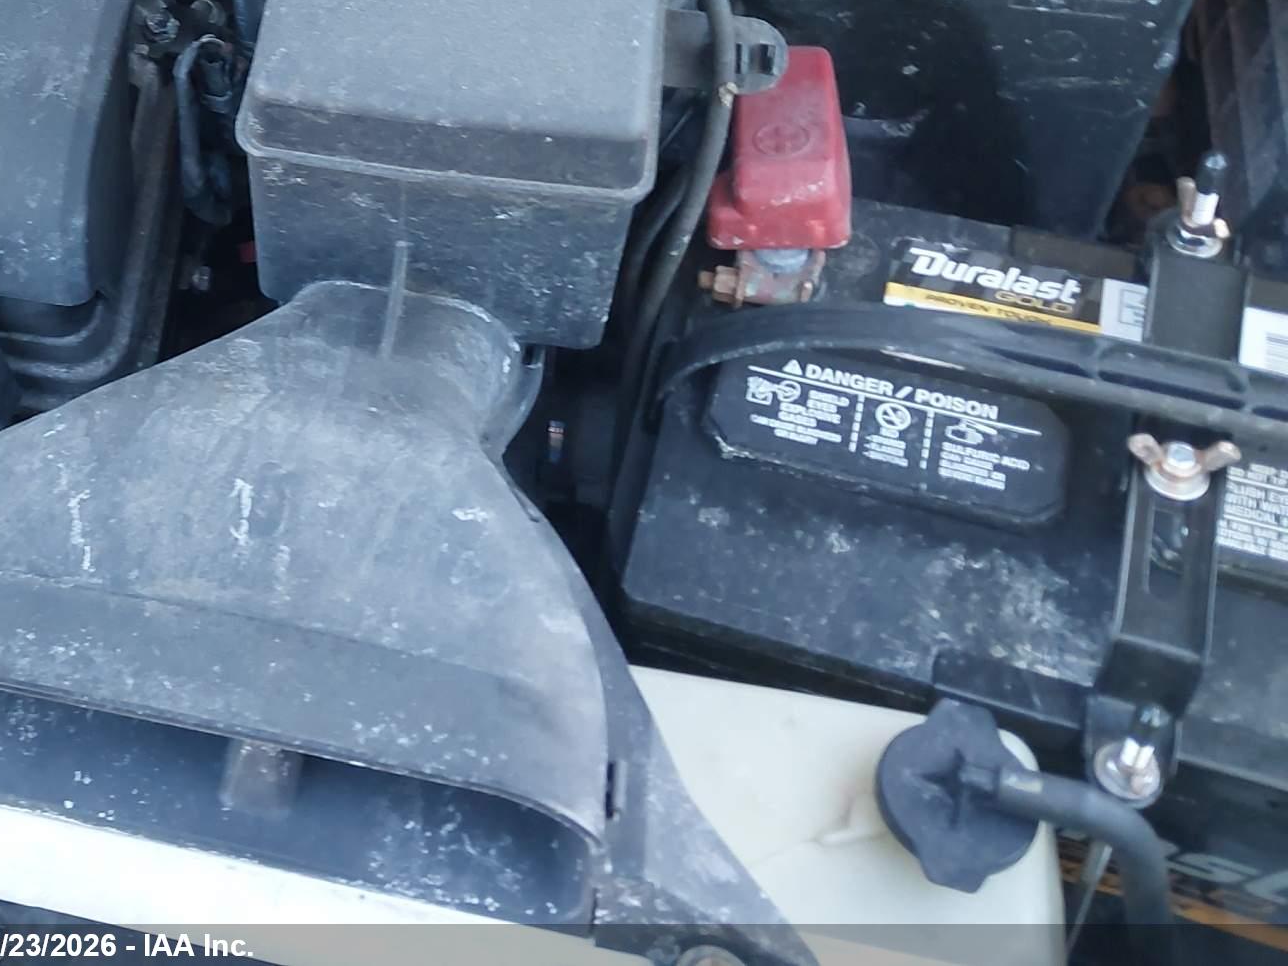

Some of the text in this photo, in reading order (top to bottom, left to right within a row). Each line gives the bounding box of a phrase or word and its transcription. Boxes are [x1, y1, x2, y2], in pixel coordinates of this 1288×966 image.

[909, 247, 1081, 304] Duralast
[925, 293, 989, 313] PROVEN
[994, 290, 1074, 315] GOLD
[805, 364, 894, 396] DANGER
[914, 388, 999, 420] POISON
